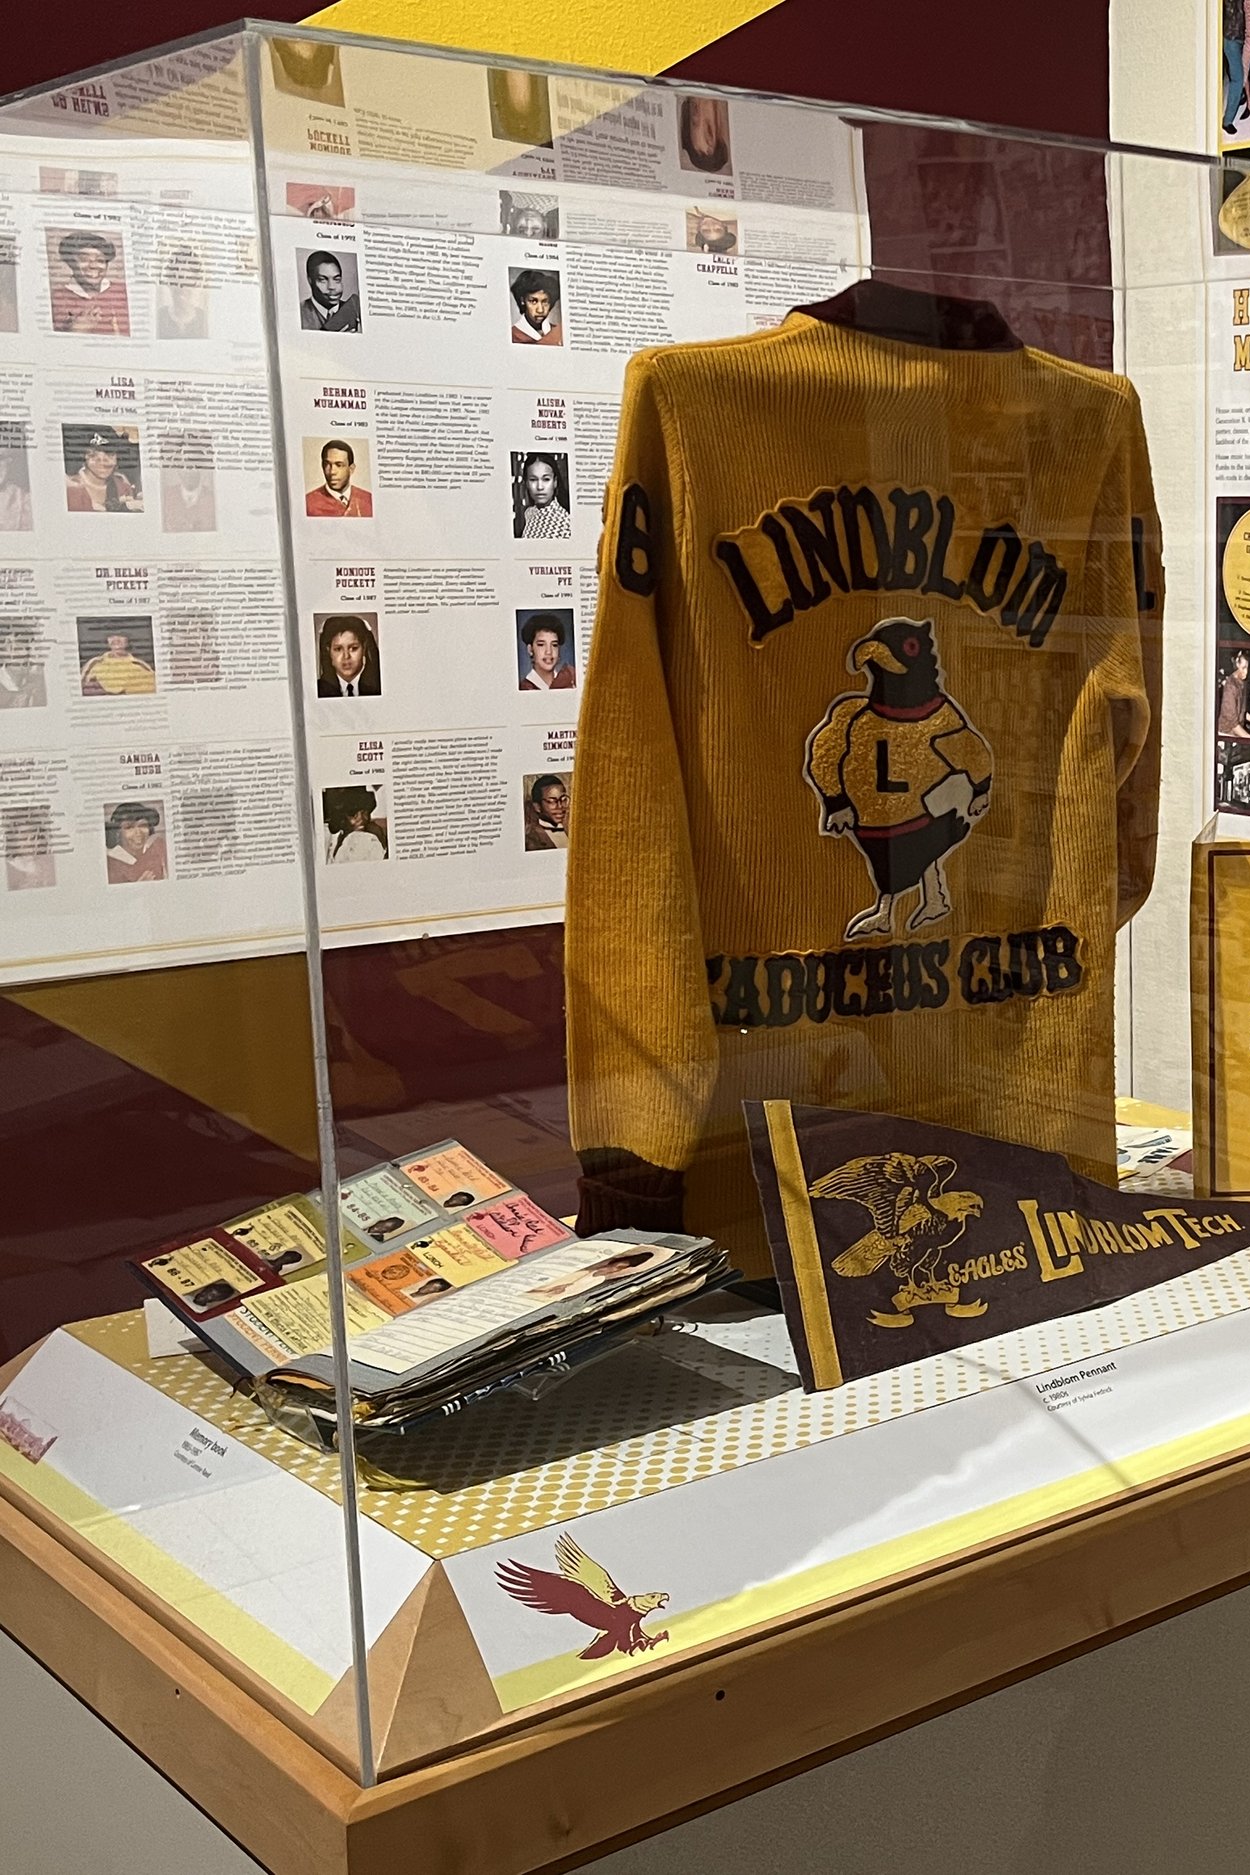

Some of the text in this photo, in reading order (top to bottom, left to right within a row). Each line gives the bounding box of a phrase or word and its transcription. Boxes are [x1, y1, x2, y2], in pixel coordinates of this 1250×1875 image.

[696, 263, 738, 276] CHAPPELLE
[110, 376, 137, 388] LISA
[95, 388, 137, 400] MAIDEN
[322, 387, 366, 398] BERNARD
[313, 398, 367, 410] MUHAMMAD
[536, 398, 566, 408] ALISHA
[530, 419, 567, 430] ROBERTS
[335, 567, 376, 577] MONIQUE
[528, 566, 572, 575] YURIALYSE
[717, 486, 1067, 647] LINDBLOM
[106, 580, 151, 592] PICKETT
[335, 578, 376, 588] PUCKETT
[557, 577, 573, 586] PYE
[358, 741, 384, 751] ELISA
[119, 753, 160, 764] SANDRA
[356, 752, 384, 762] SCOTT
[876, 740, 909, 792] L
[960, 926, 1083, 1004] CLUB
[1017, 1199, 1174, 1283] LINDBLOM
[1036, 1361, 1117, 1394] Lindblom Pennant
[1047, 1401, 1072, 1412] Courtesy
[189, 1427, 229, 1457] Memory book
